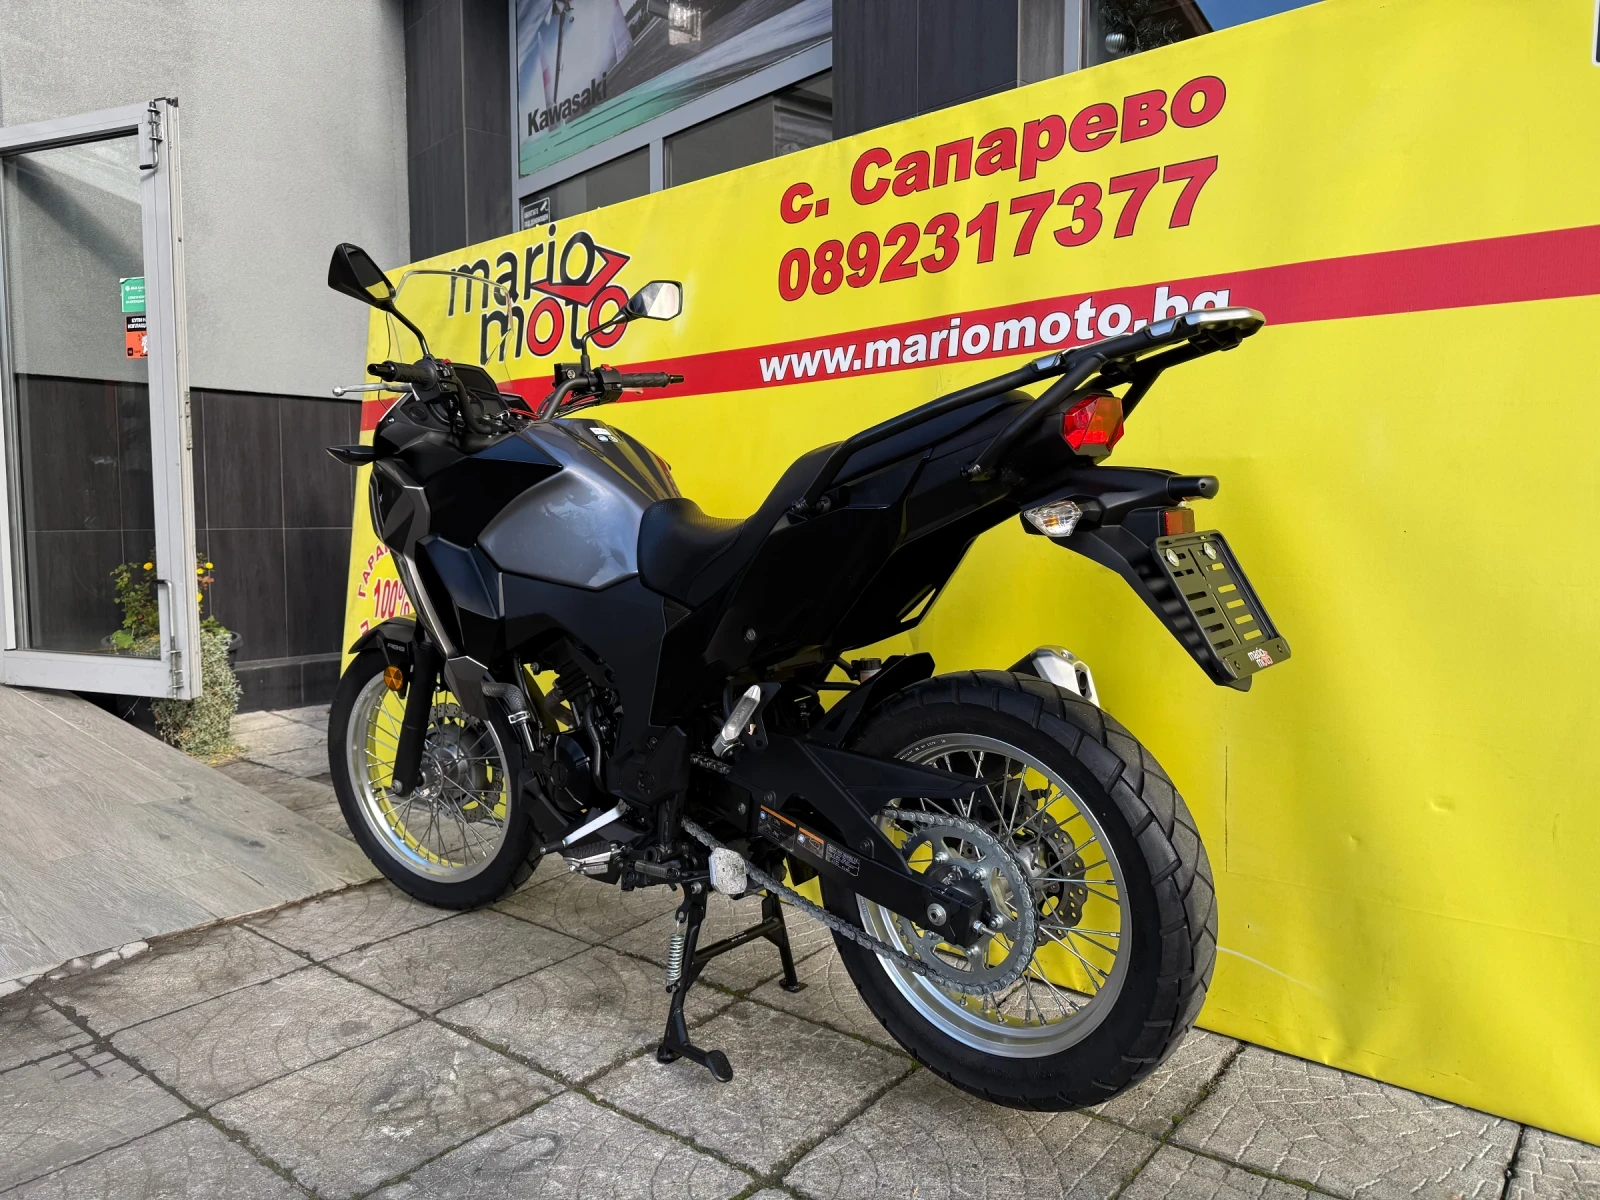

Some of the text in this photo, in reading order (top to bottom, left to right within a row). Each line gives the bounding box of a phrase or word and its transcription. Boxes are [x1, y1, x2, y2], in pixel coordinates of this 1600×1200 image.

[527, 72, 608, 136] Kawasaki
[780, 75, 1227, 224] с. Сапарево
[447, 223, 596, 317] mario
[778, 155, 1219, 302] 0892317377
[479, 285, 630, 366] moto
[374, 578, 411, 619] 100%
